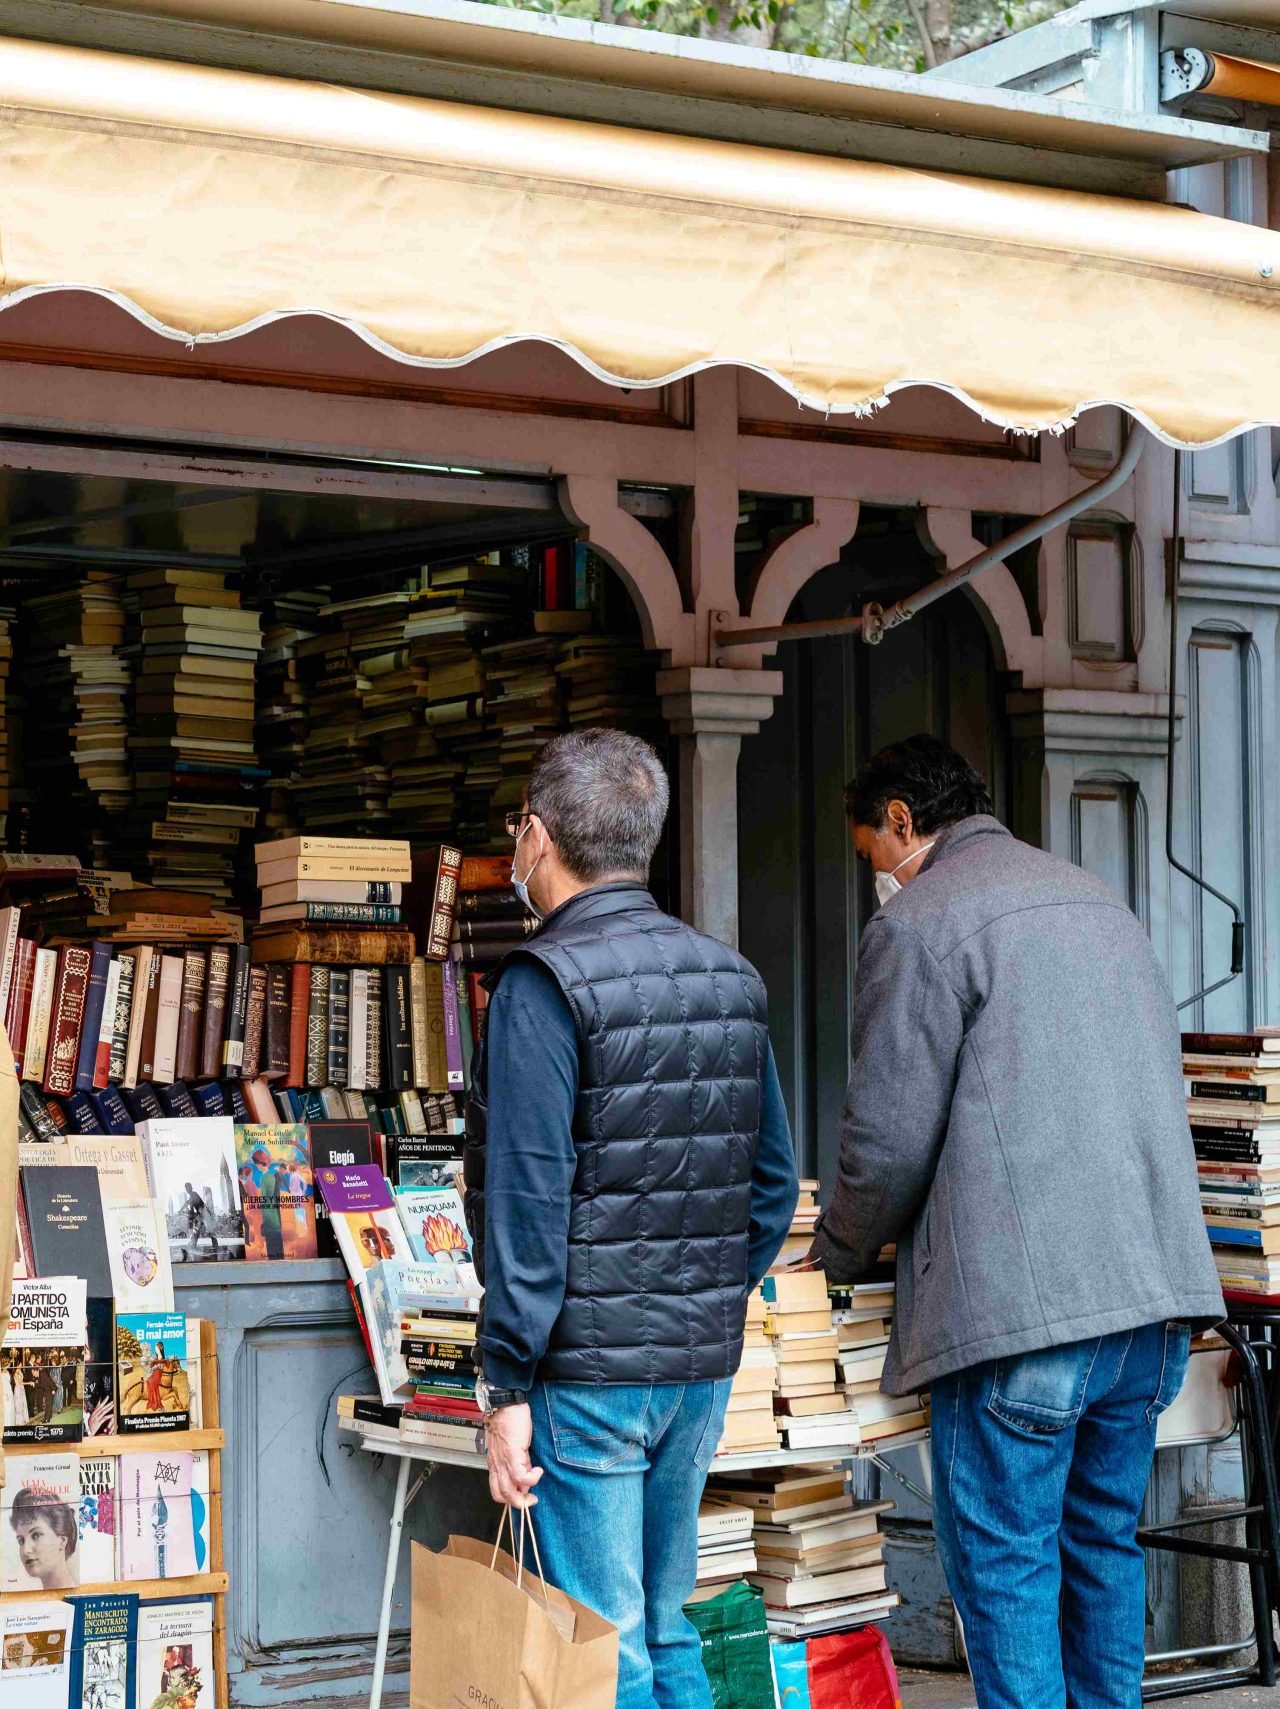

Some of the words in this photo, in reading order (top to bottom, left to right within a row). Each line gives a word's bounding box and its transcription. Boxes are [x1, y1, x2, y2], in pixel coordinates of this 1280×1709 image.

[75, 1146, 101, 1163] Ortega
[112, 1146, 138, 1162] Gasset
[329, 1150, 355, 1166] Elegía
[408, 1202, 457, 1214] NUNQUAM
[47, 1215, 87, 1223] Shakespeare
[18, 1294, 66, 1305] PARTIDO
[11, 1306, 70, 1318] OMUNISTA
[7, 1320, 21, 1330] en
[23, 1318, 63, 1333] España
[136, 1329, 144, 1340] El
[145, 1329, 157, 1340] mal
[159, 1329, 185, 1339] amor
[50, 1428, 64, 1436] 1979
[84, 1609, 128, 1620] MANUSCRITO
[84, 1618, 128, 1627] ENCONTRADO
[159, 1623, 168, 1631] La
[170, 1622, 192, 1630] ternura
[84, 1626, 92, 1634] EN
[94, 1624, 128, 1634] ZARAGOZA
